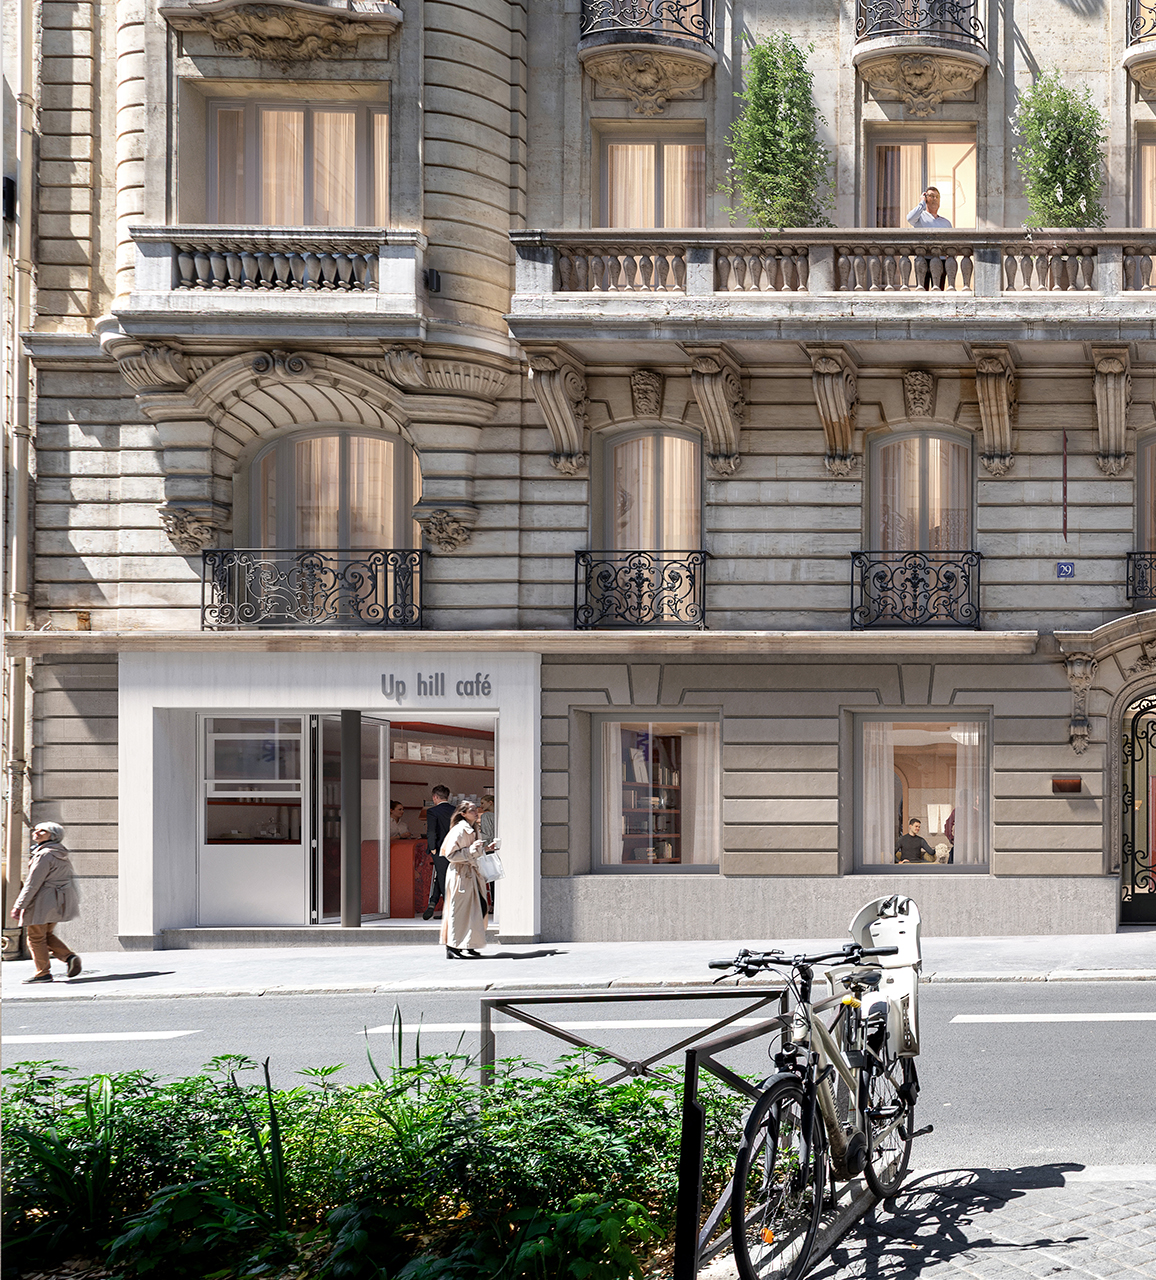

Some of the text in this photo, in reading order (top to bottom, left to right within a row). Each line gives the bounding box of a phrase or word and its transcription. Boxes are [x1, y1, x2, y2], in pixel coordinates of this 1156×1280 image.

[1060, 565, 1071, 576] 29
[381, 672, 492, 704] Up hill café
